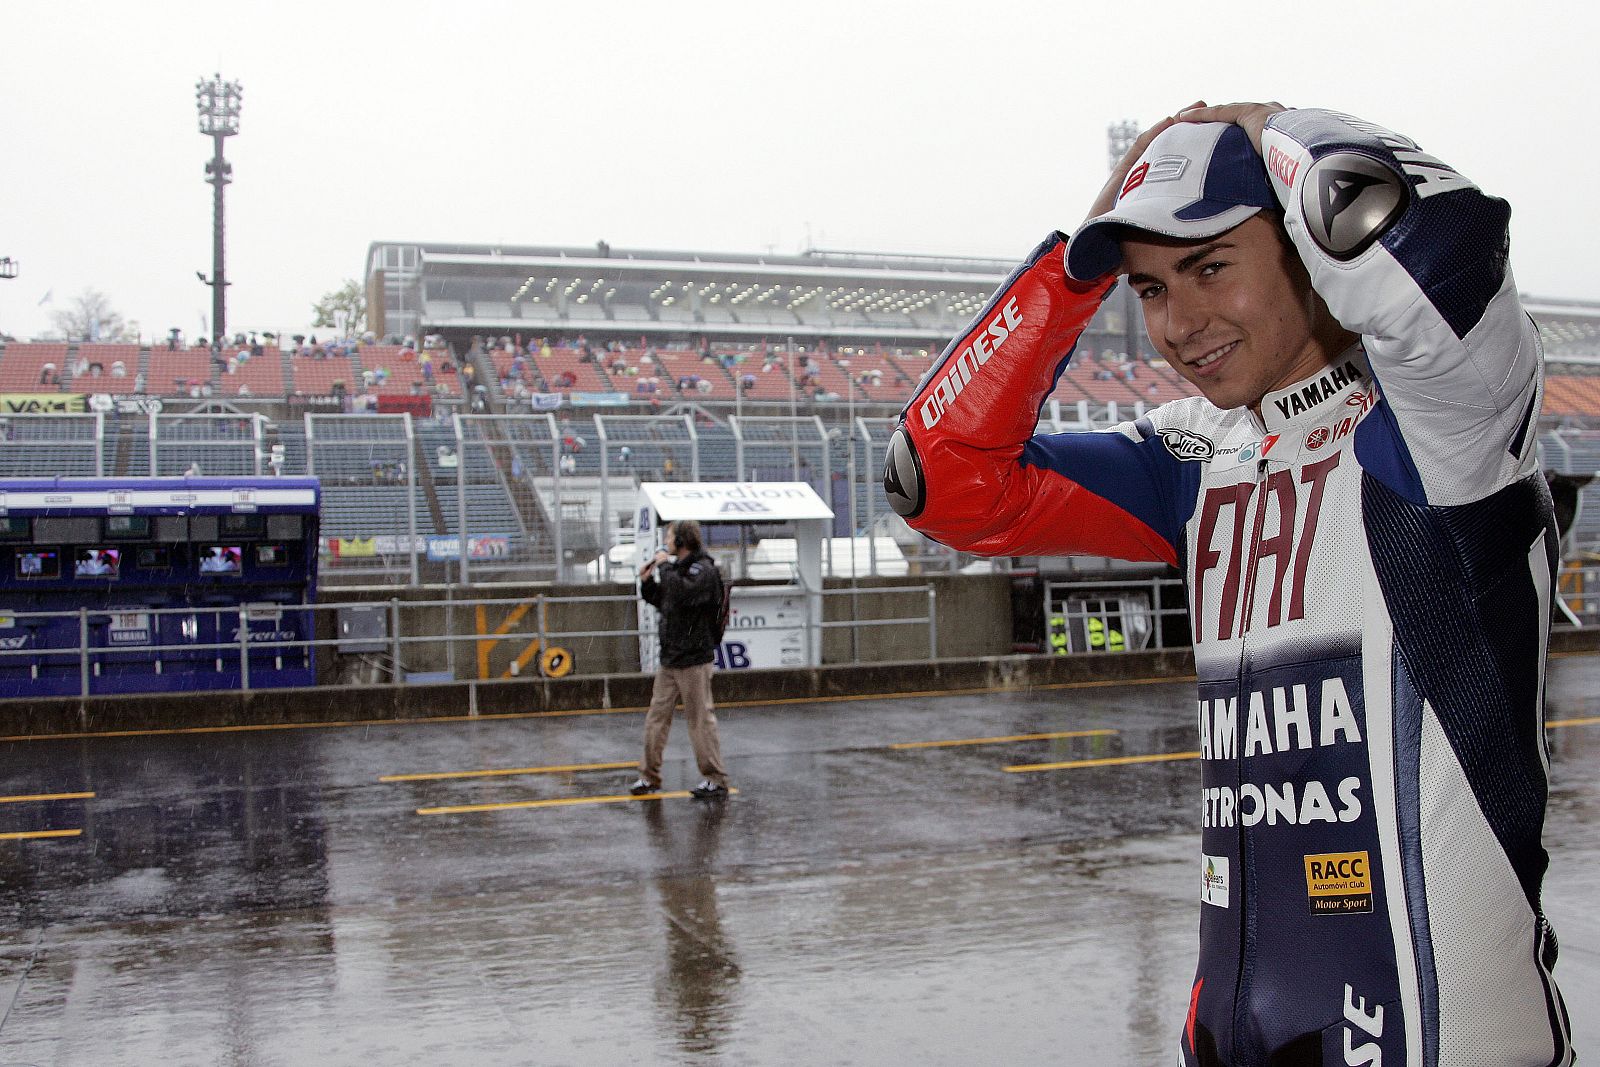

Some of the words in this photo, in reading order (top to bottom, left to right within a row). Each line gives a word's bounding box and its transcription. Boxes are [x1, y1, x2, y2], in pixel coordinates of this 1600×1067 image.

[1274, 361, 1363, 419] YAMAHA
[660, 485, 805, 500] cardion
[718, 501, 771, 513] AB
[1195, 450, 1341, 644] FIAT
[727, 609, 766, 627] ion
[1199, 677, 1362, 760] AMAHA
[1202, 777, 1362, 827] ETRONAS
[1310, 858, 1364, 880] RACC
[1349, 881, 1365, 889] Club
[1315, 900, 1340, 909] Motor
[1343, 898, 1367, 910] Sport
